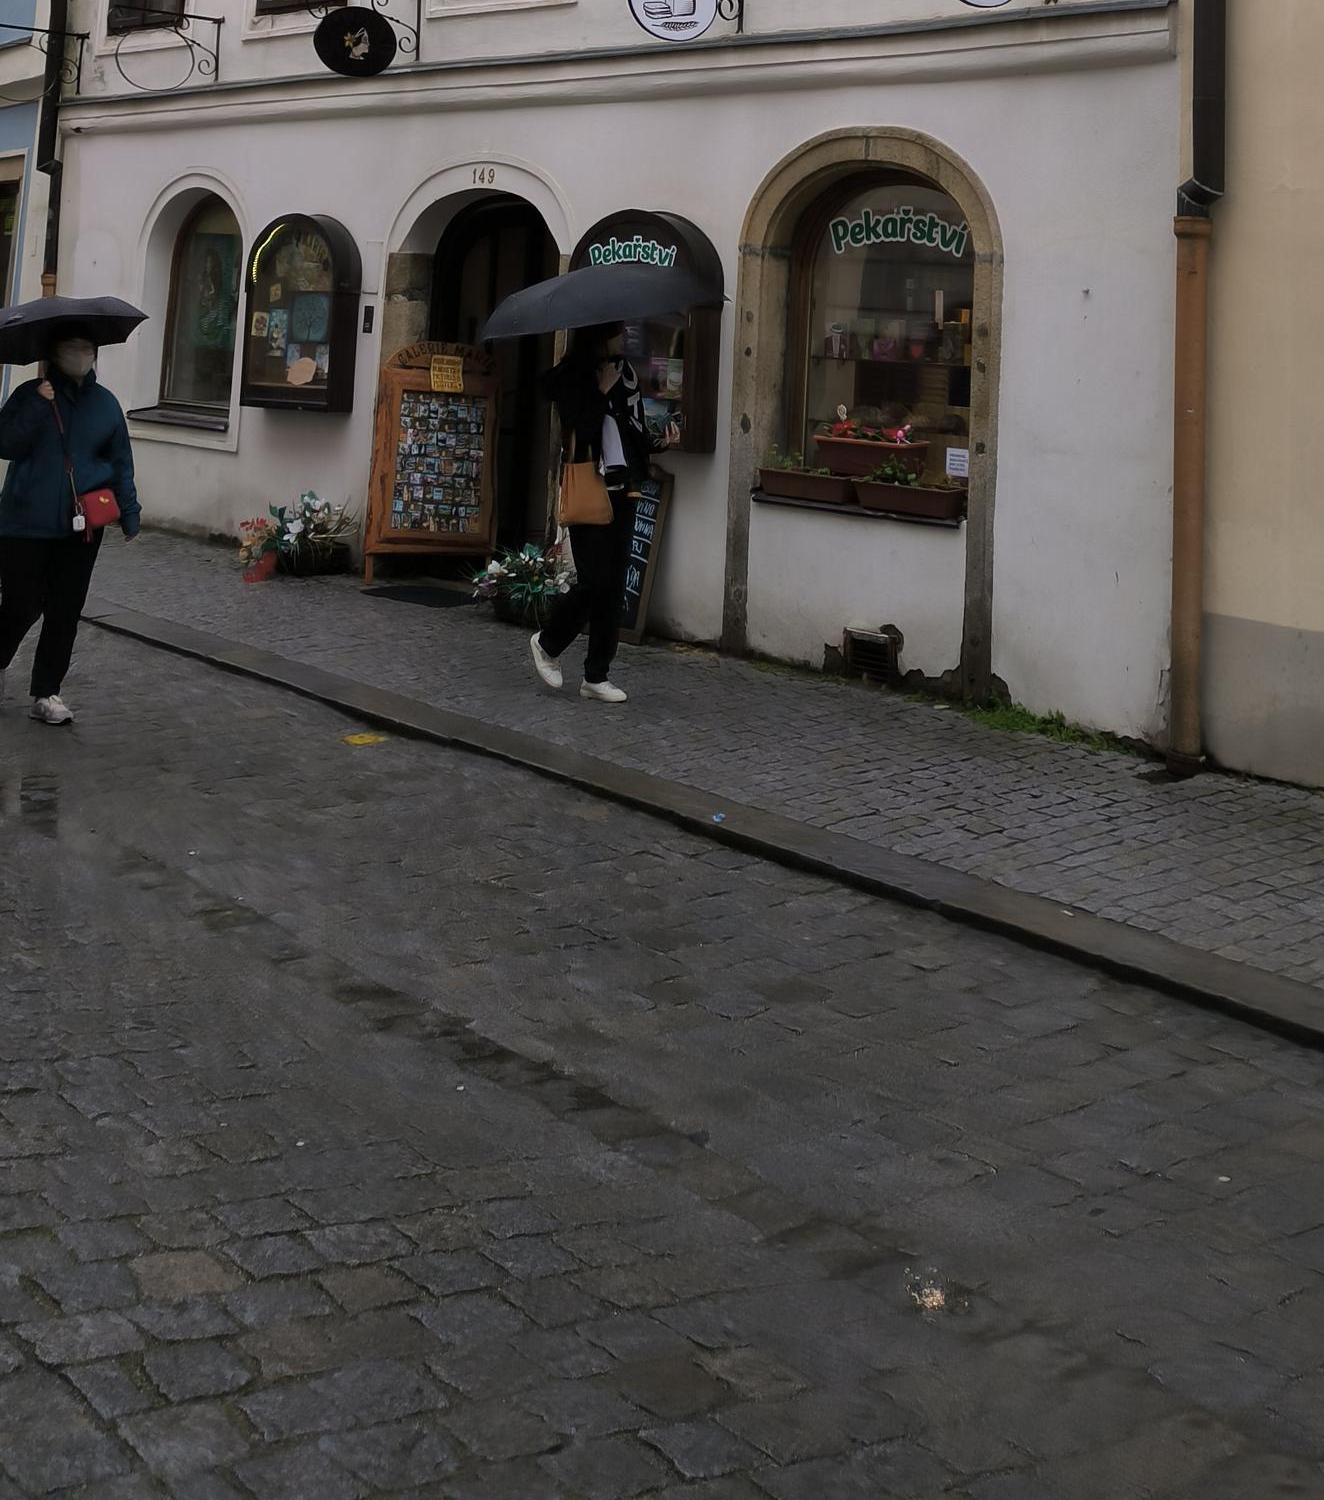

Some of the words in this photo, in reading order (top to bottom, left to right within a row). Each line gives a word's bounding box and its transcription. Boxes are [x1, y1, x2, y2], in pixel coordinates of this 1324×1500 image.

[472, 167, 495, 184] 149
[829, 205, 971, 258] Pekařství
[589, 235, 678, 267] Pekařství
[398, 341, 448, 365] GALERIE
